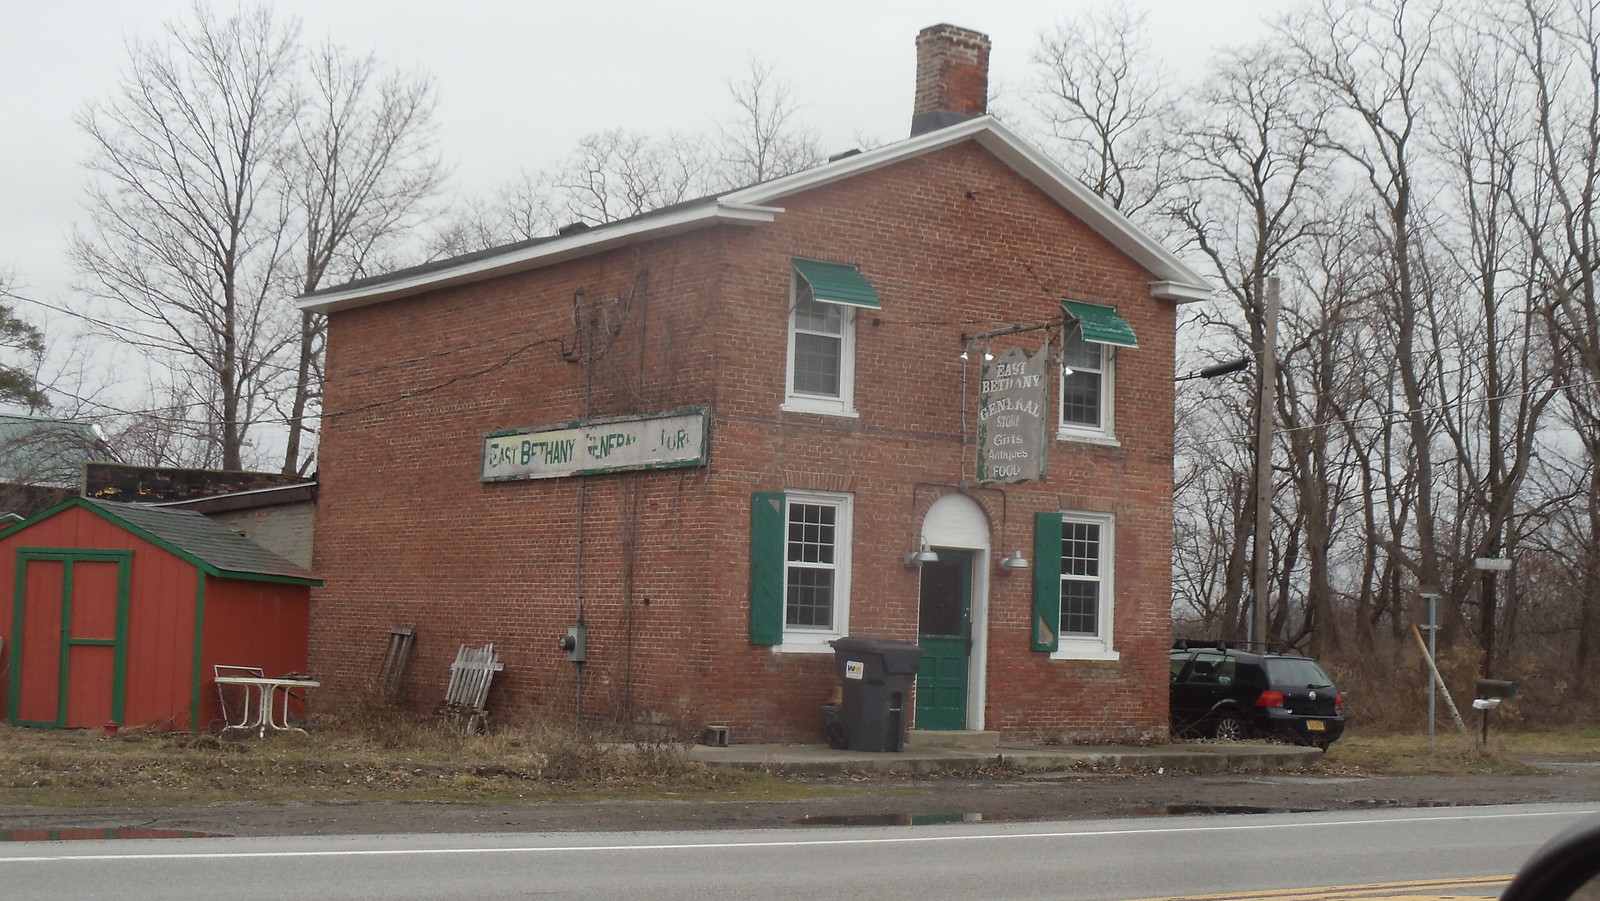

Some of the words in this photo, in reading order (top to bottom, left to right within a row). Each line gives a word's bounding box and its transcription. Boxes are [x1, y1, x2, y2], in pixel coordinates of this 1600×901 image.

[996, 361, 1027, 378] EAST
[520, 439, 576, 466] BETHANY
[987, 448, 1028, 461] Antiques
[993, 464, 1021, 478] FOOD
